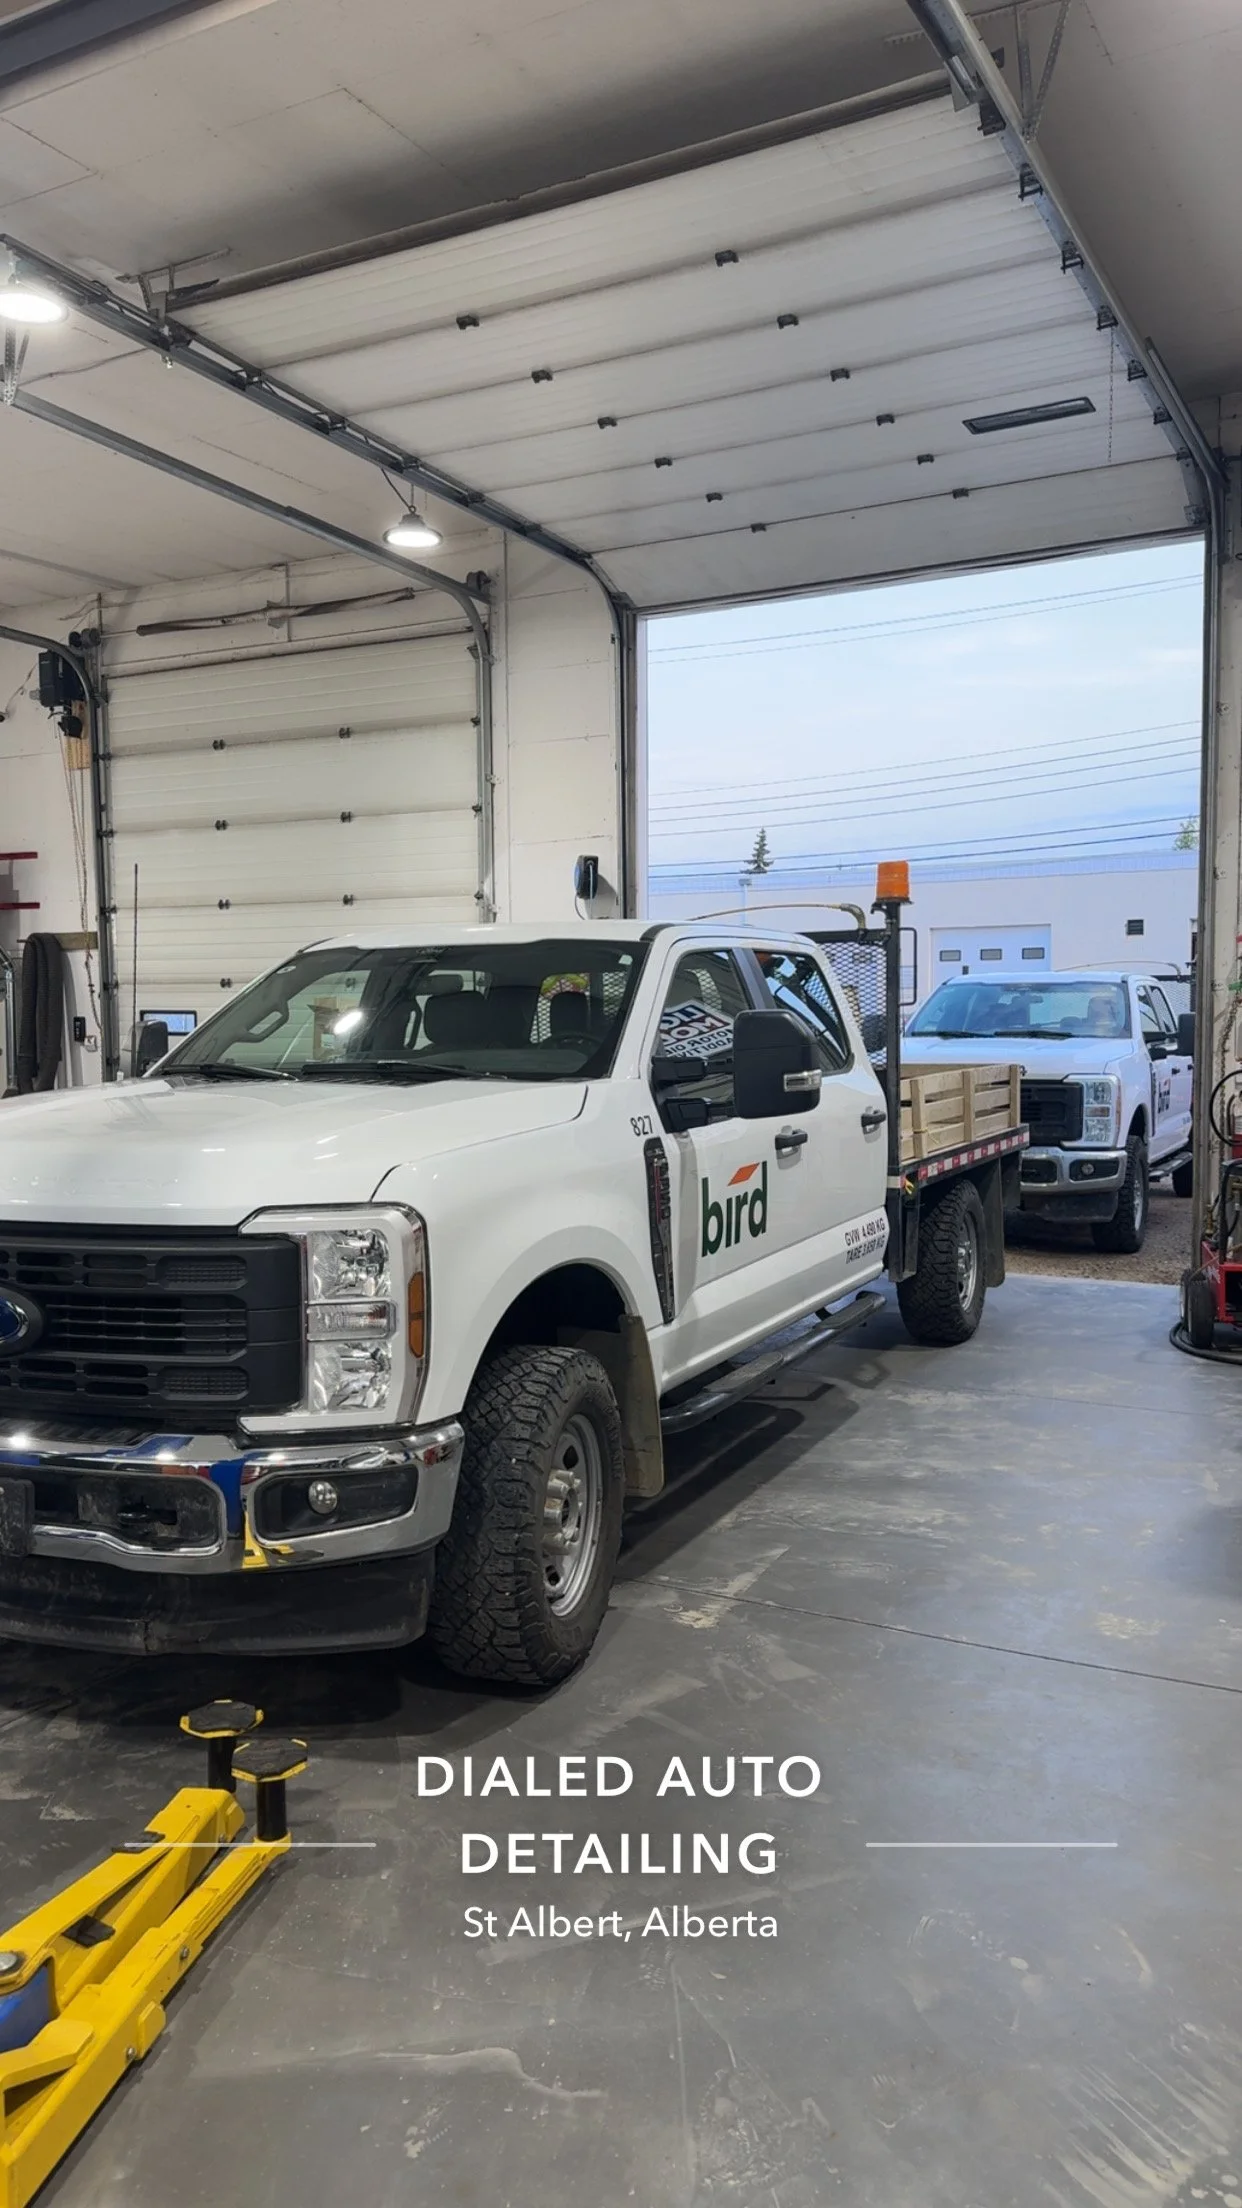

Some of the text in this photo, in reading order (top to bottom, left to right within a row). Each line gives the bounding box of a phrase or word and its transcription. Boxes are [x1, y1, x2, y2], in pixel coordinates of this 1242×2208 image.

[630, 1115, 653, 1137] 827
[701, 1160, 768, 1258] bird
[844, 1228, 860, 1247] GVW
